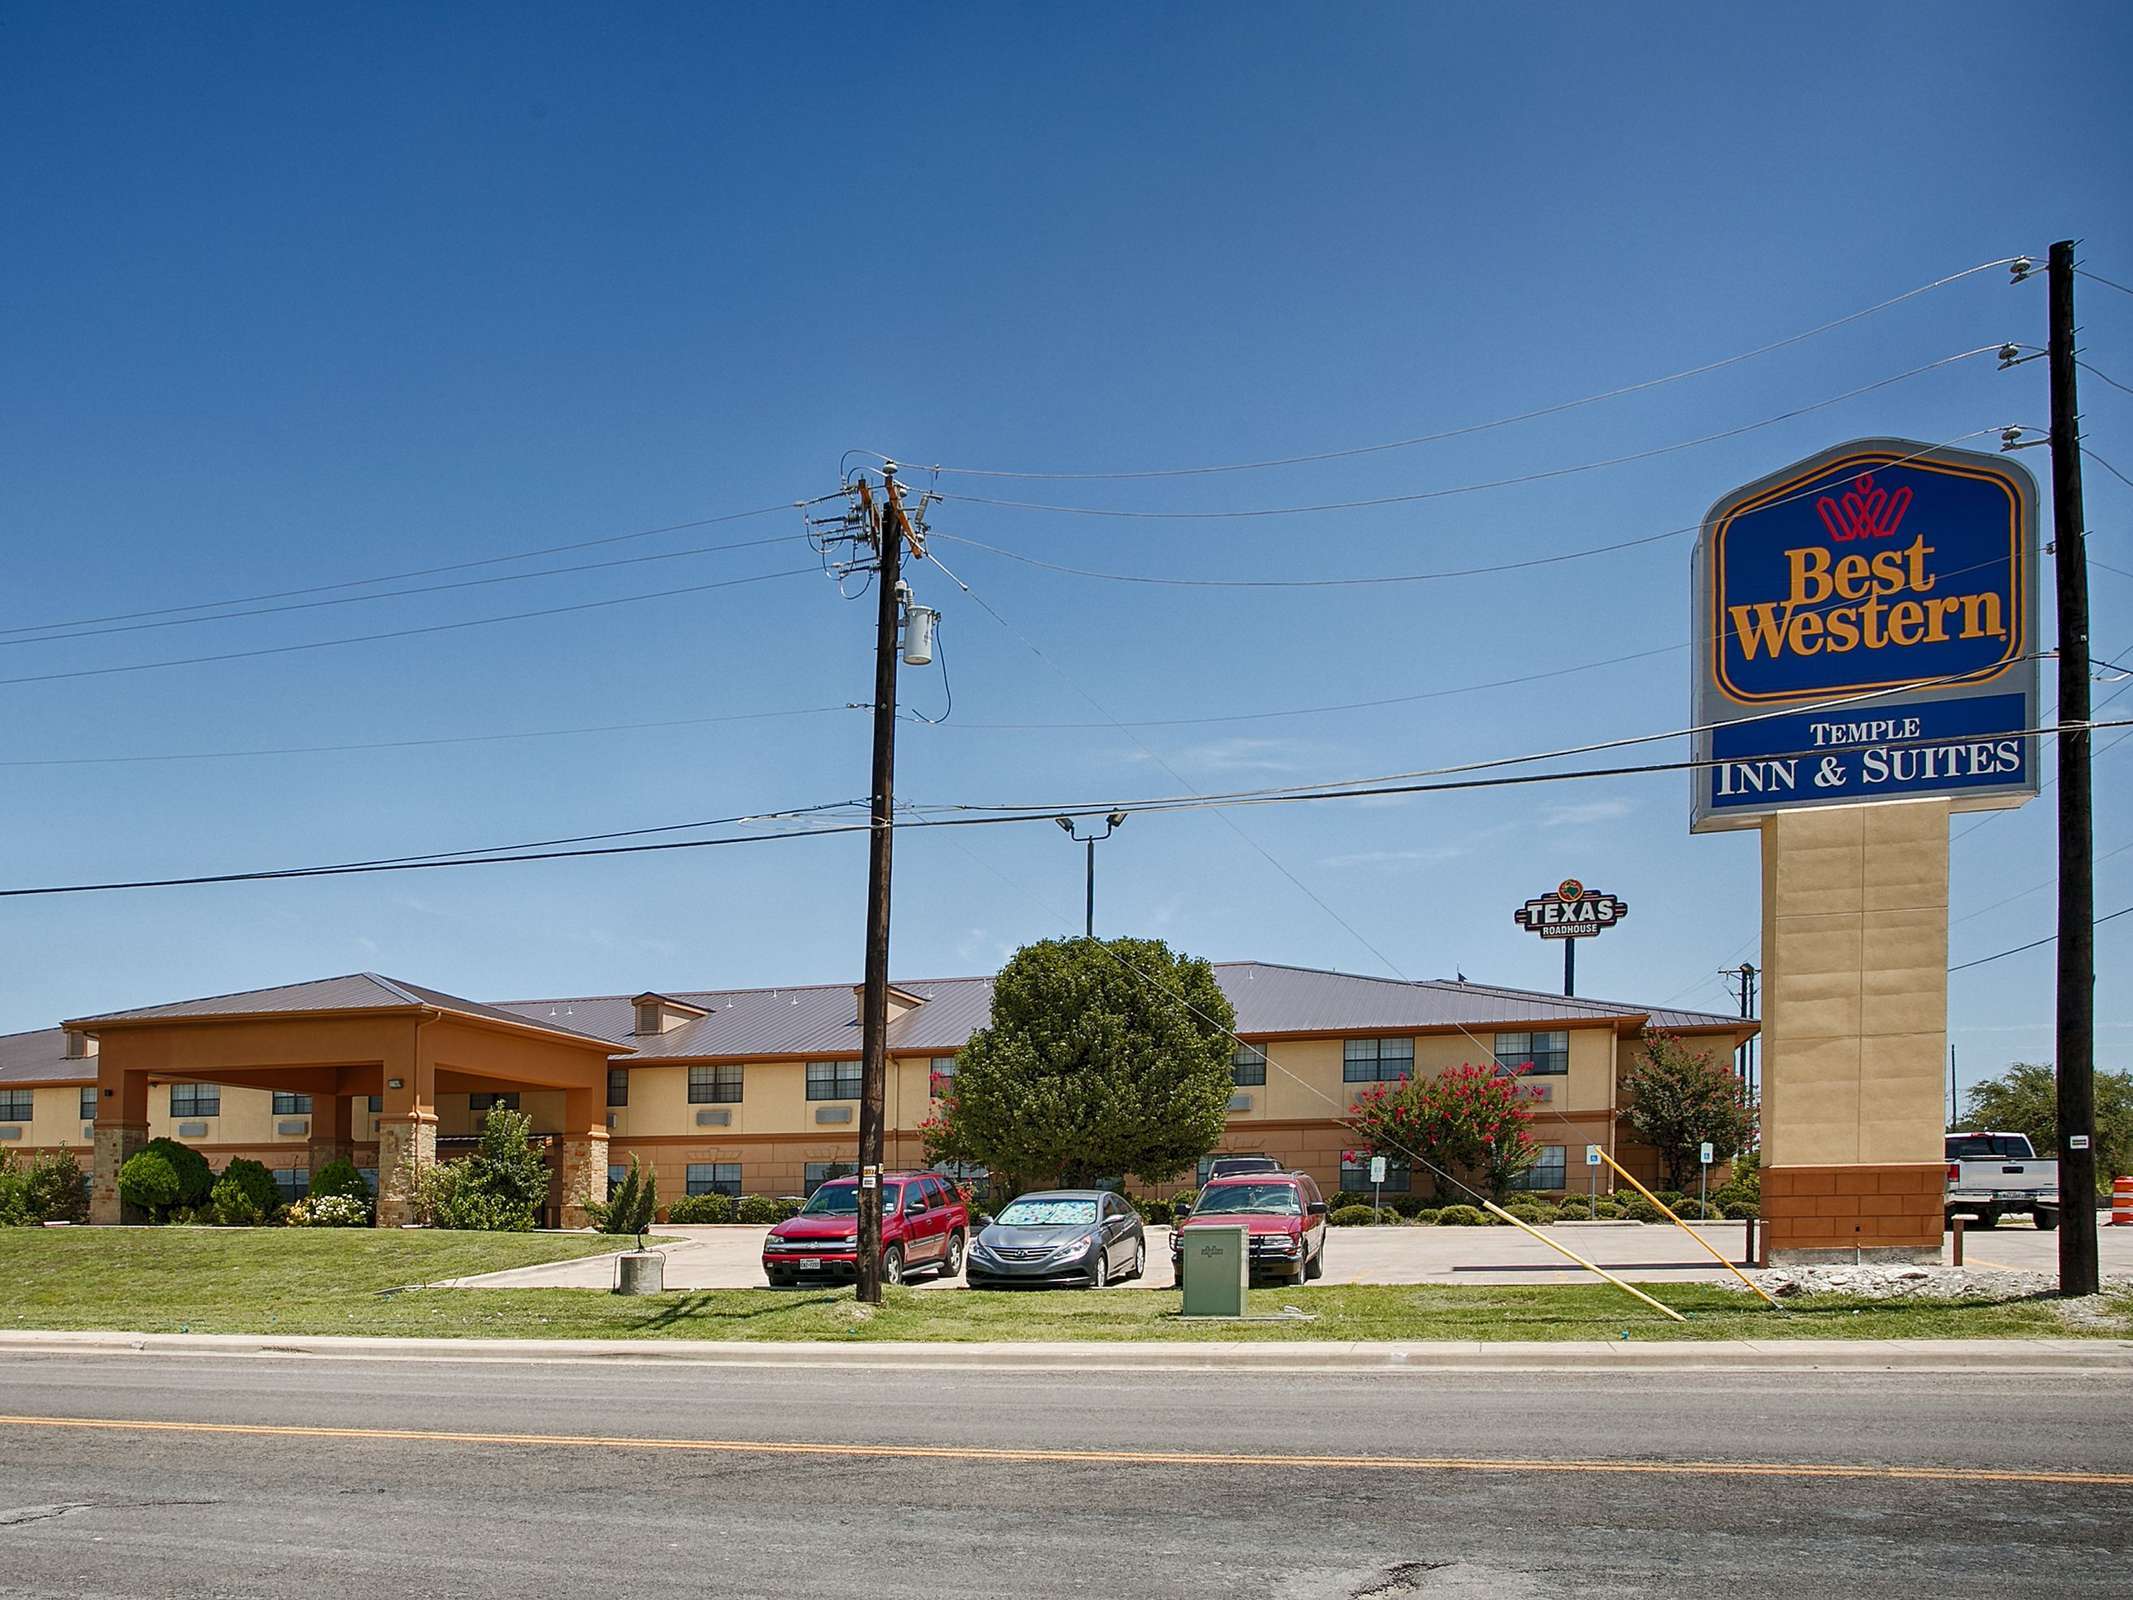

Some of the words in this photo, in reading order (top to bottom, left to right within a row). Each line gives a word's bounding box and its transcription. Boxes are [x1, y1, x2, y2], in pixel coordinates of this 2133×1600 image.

[1784, 534, 1936, 606] Best
[1728, 591, 2006, 661] Western
[1810, 718, 1920, 746] TEMPLE
[1718, 760, 1798, 796] INN
[1814, 756, 1847, 788] &
[1863, 742, 2020, 784] SUITES
[1527, 901, 1614, 924] TEXAS
[1543, 924, 1598, 935] ROADHOUSE
